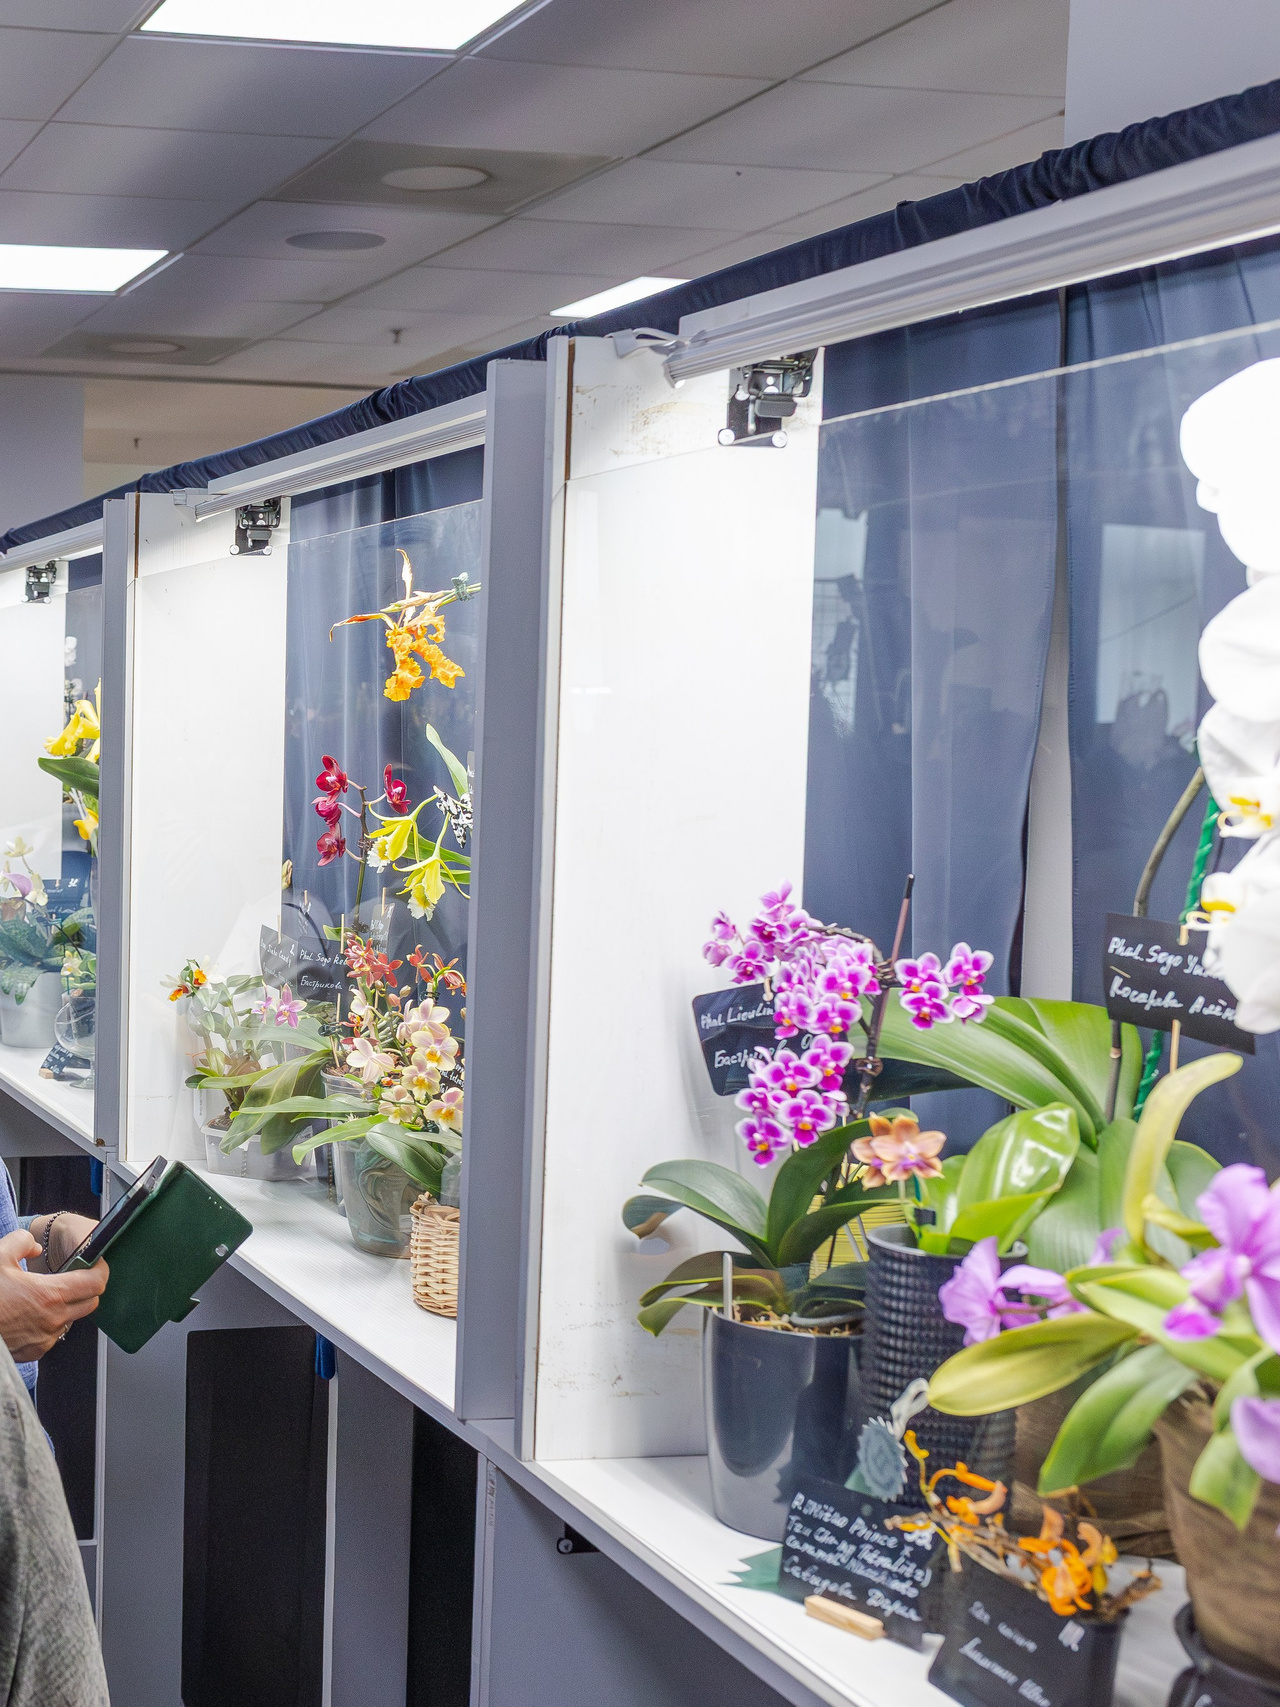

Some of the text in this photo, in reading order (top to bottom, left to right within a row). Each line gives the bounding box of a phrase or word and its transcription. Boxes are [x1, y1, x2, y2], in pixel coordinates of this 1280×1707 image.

[315, 952, 332, 967] Sogo
[1145, 944, 1184, 976] Sogo
[300, 975, 343, 991] Бастрикова
[1188, 995, 1236, 1021] Алён
[848, 1516, 899, 1549] Prince
